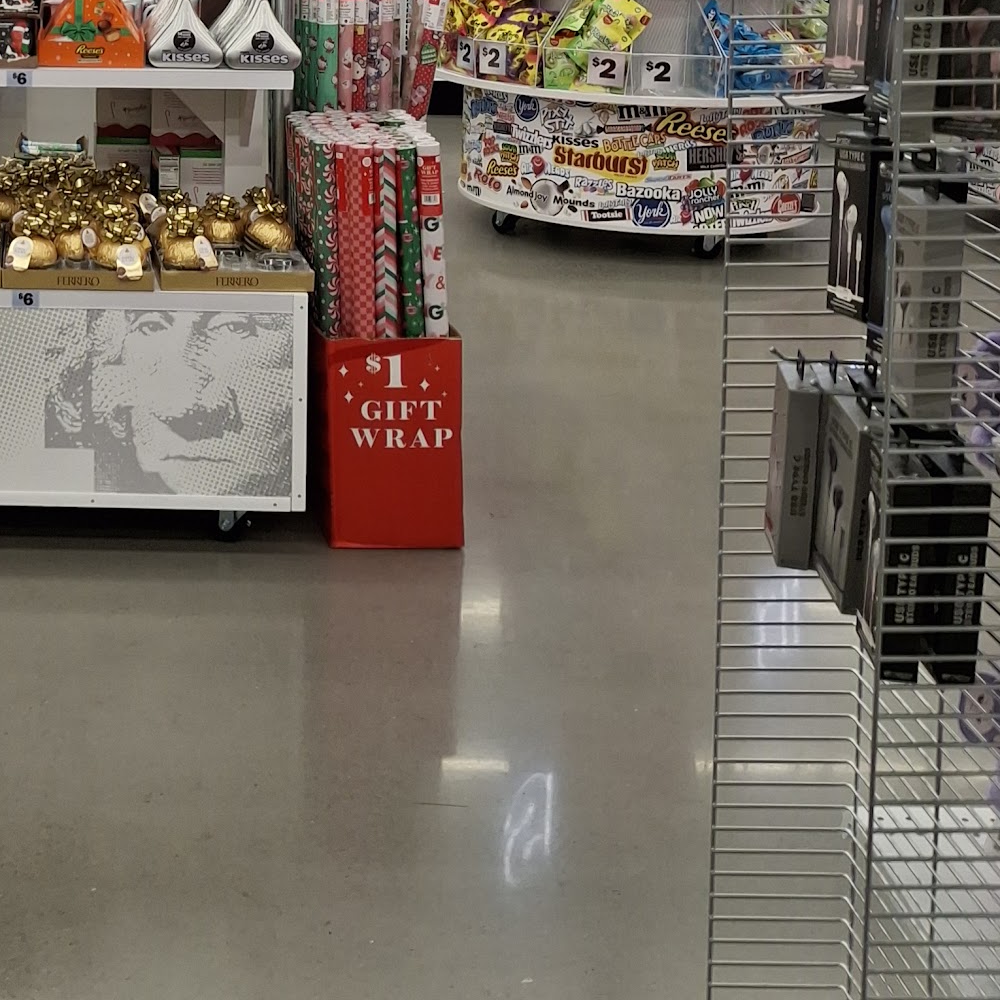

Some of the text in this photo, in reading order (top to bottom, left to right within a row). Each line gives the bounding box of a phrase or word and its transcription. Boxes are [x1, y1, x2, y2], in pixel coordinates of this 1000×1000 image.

[459, 41, 471, 63] $2
[482, 47, 500, 68] $2
[592, 56, 617, 79] $2
[646, 60, 671, 82] $2
[12, 72, 27, 85] $6
[511, 123, 554, 150] Twizzlers
[602, 132, 667, 153] BOTTLE CAPS
[487, 158, 519, 177] Reese's
[554, 146, 649, 175] Starburst
[506, 185, 534, 198] Almond
[552, 194, 596, 209] Mounds
[616, 181, 682, 202] Bazooka
[689, 186, 718, 200] JOLLY
[590, 210, 623, 219] Tootsie
[635, 201, 669, 223] York
[692, 203, 725, 223] NOW
[57, 276, 100, 287] FERRERO
[215, 276, 259, 287] FERRERO
[18, 292, 34, 306] $6
[365, 353, 408, 389] $1
[360, 400, 442, 421] GIFT
[350, 427, 453, 449] WRAP
